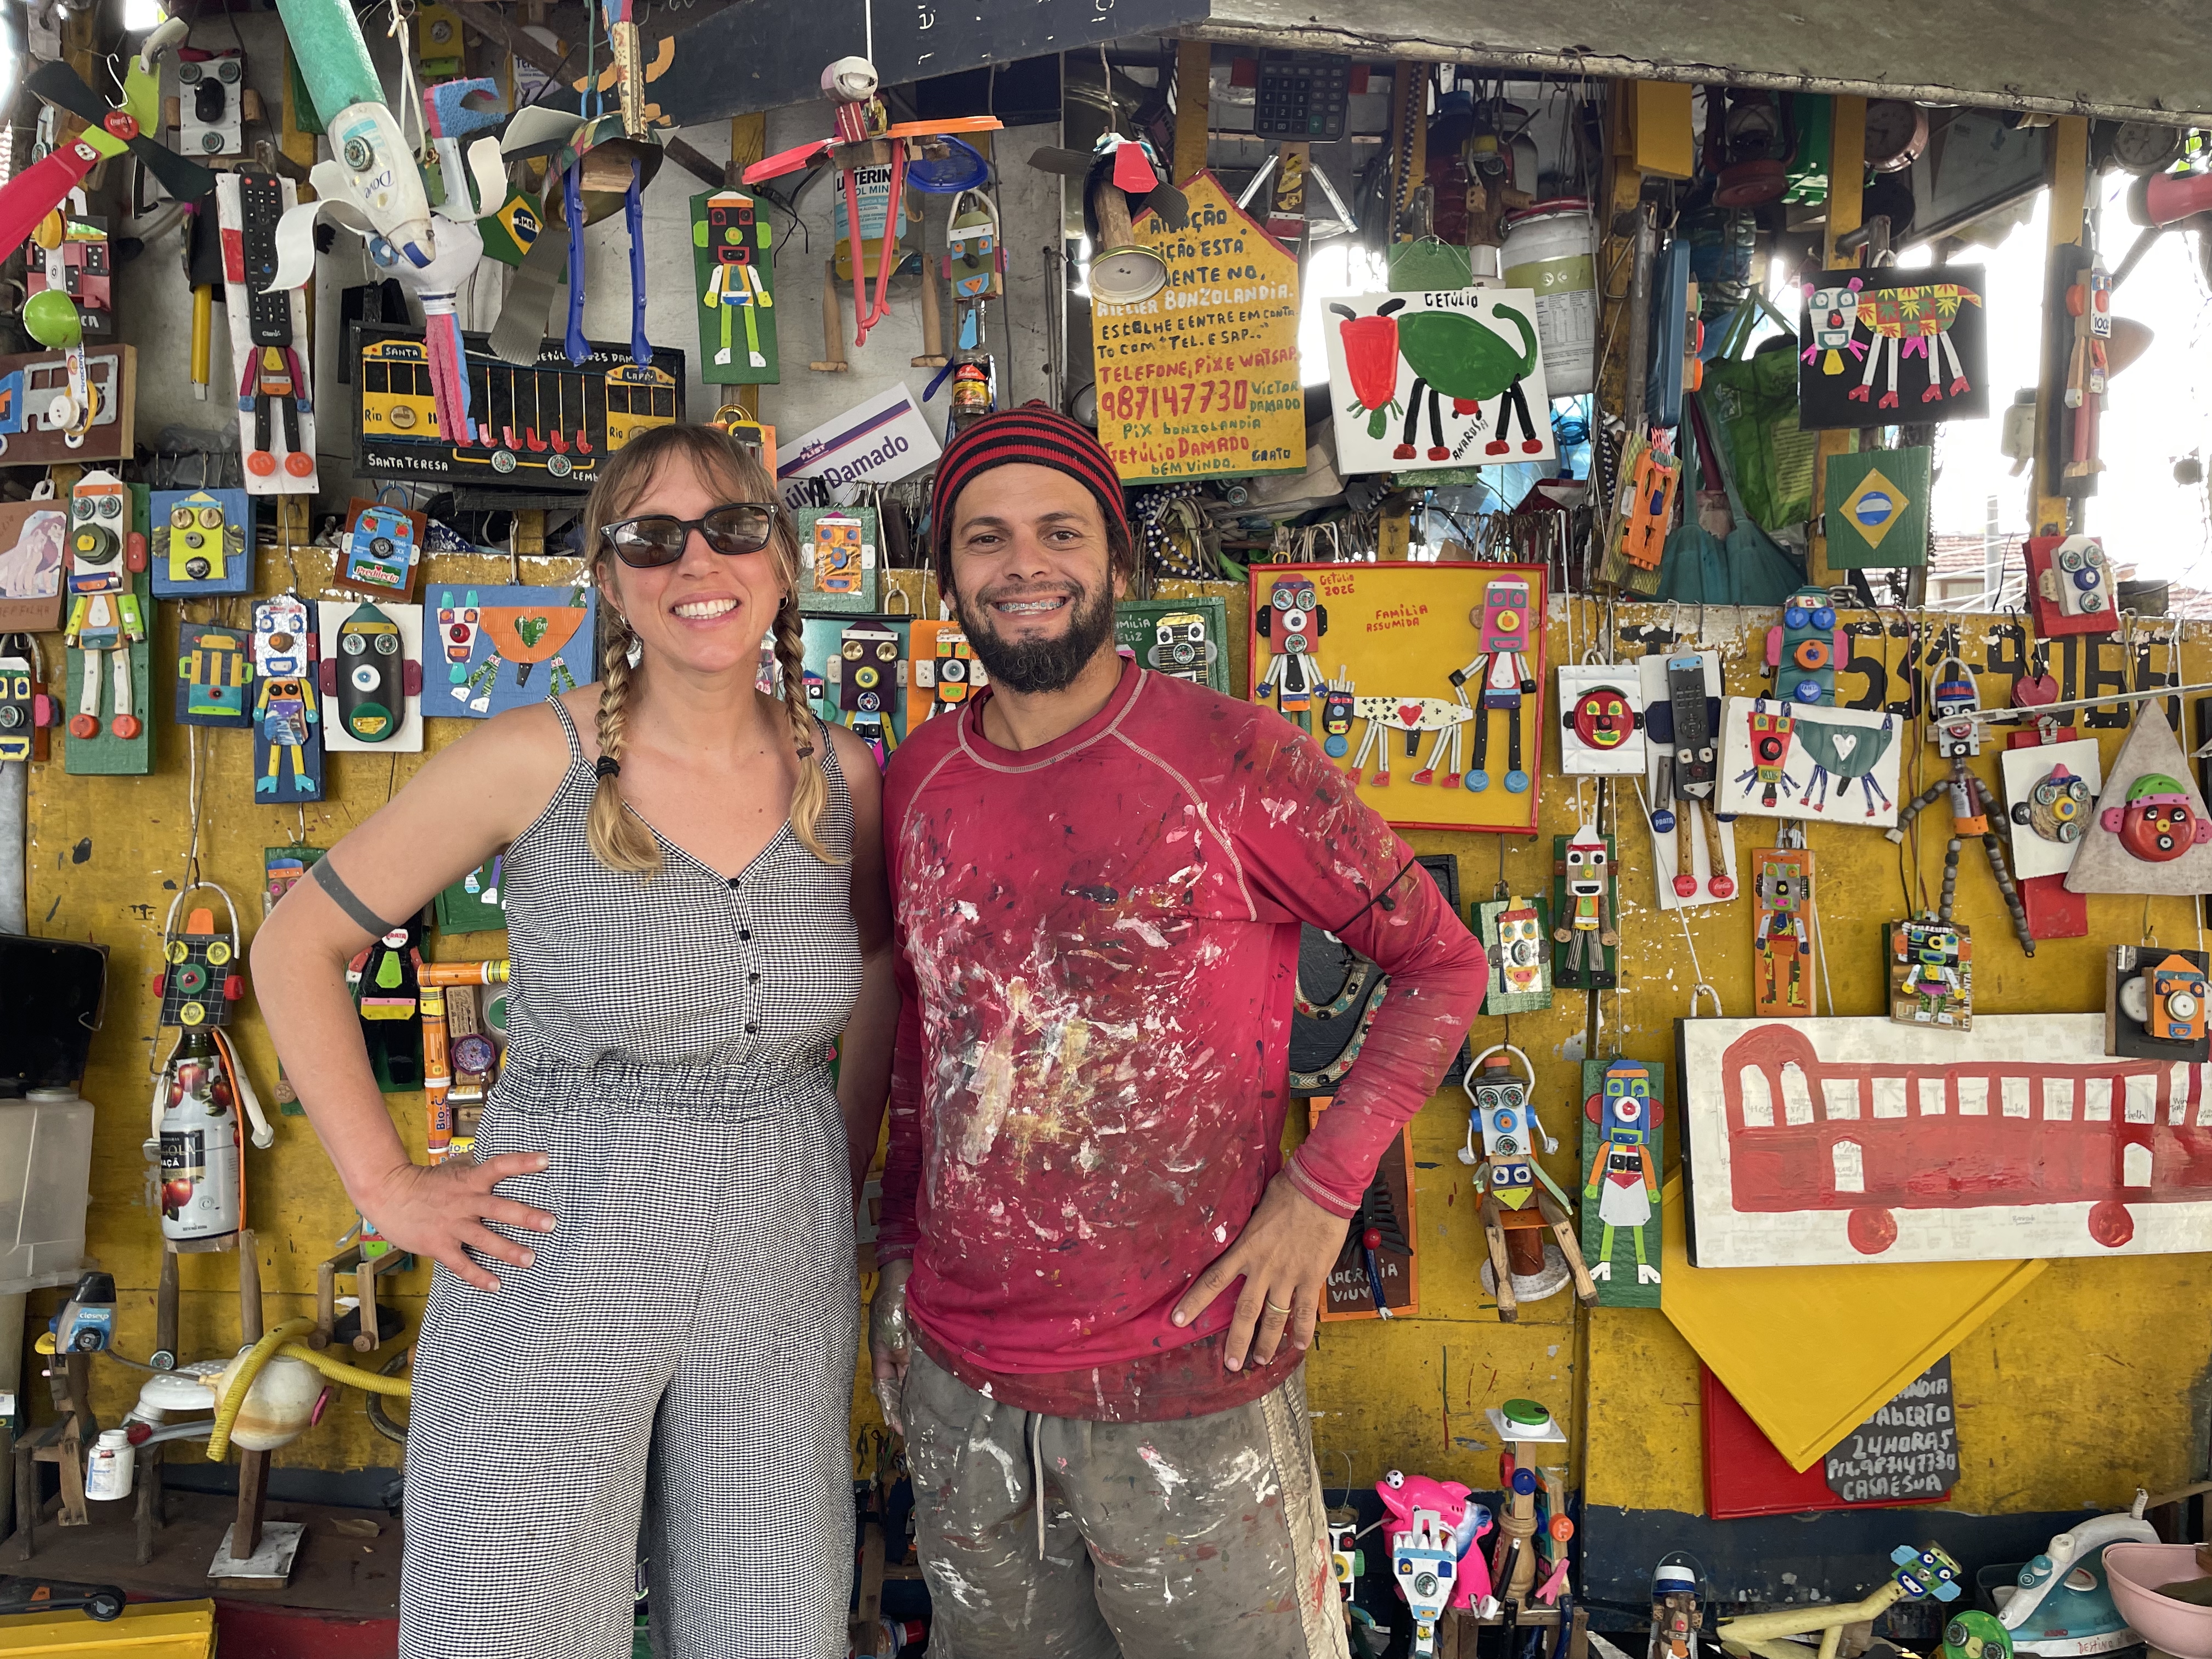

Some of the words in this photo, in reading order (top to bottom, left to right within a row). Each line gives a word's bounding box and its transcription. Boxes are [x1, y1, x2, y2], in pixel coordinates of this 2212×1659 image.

[364, 170, 395, 199] Dove
[1165, 266, 1221, 287] ENTE
[1240, 308, 1260, 321] EM
[385, 347, 419, 357] SANTA
[1120, 342, 1156, 356] COM
[1101, 379, 1248, 421] 987147730
[609, 426, 623, 439] Rio
[1452, 419, 1489, 461] ANAROSA
[823, 436, 909, 489] Damado
[356, 566, 399, 583] Predilecta
[436, 1097, 445, 1131] Bio-C
[1331, 1285, 1370, 1303] VIUV
[79, 1312, 110, 1322] closeup
